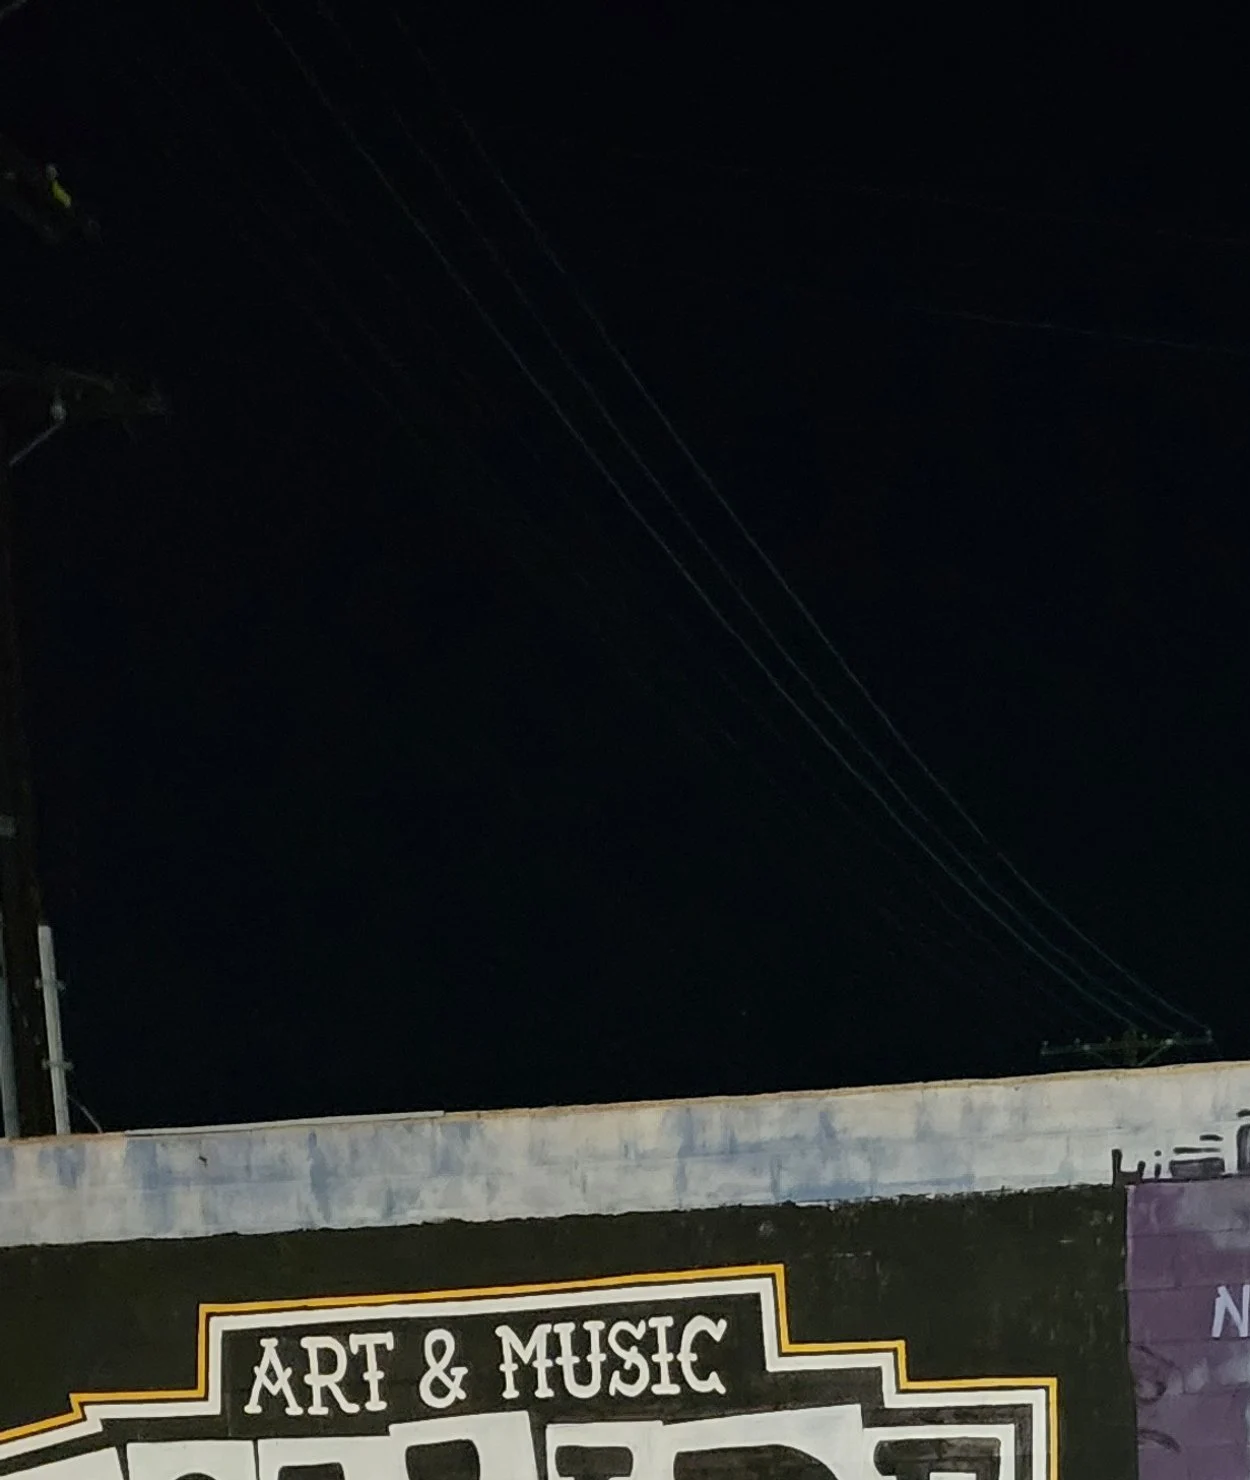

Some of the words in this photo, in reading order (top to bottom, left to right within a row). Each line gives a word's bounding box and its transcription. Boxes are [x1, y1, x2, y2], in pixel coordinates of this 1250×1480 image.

[243, 1331, 395, 1416] ART
[418, 1327, 469, 1410] &
[494, 1315, 728, 1401] MUSIC
